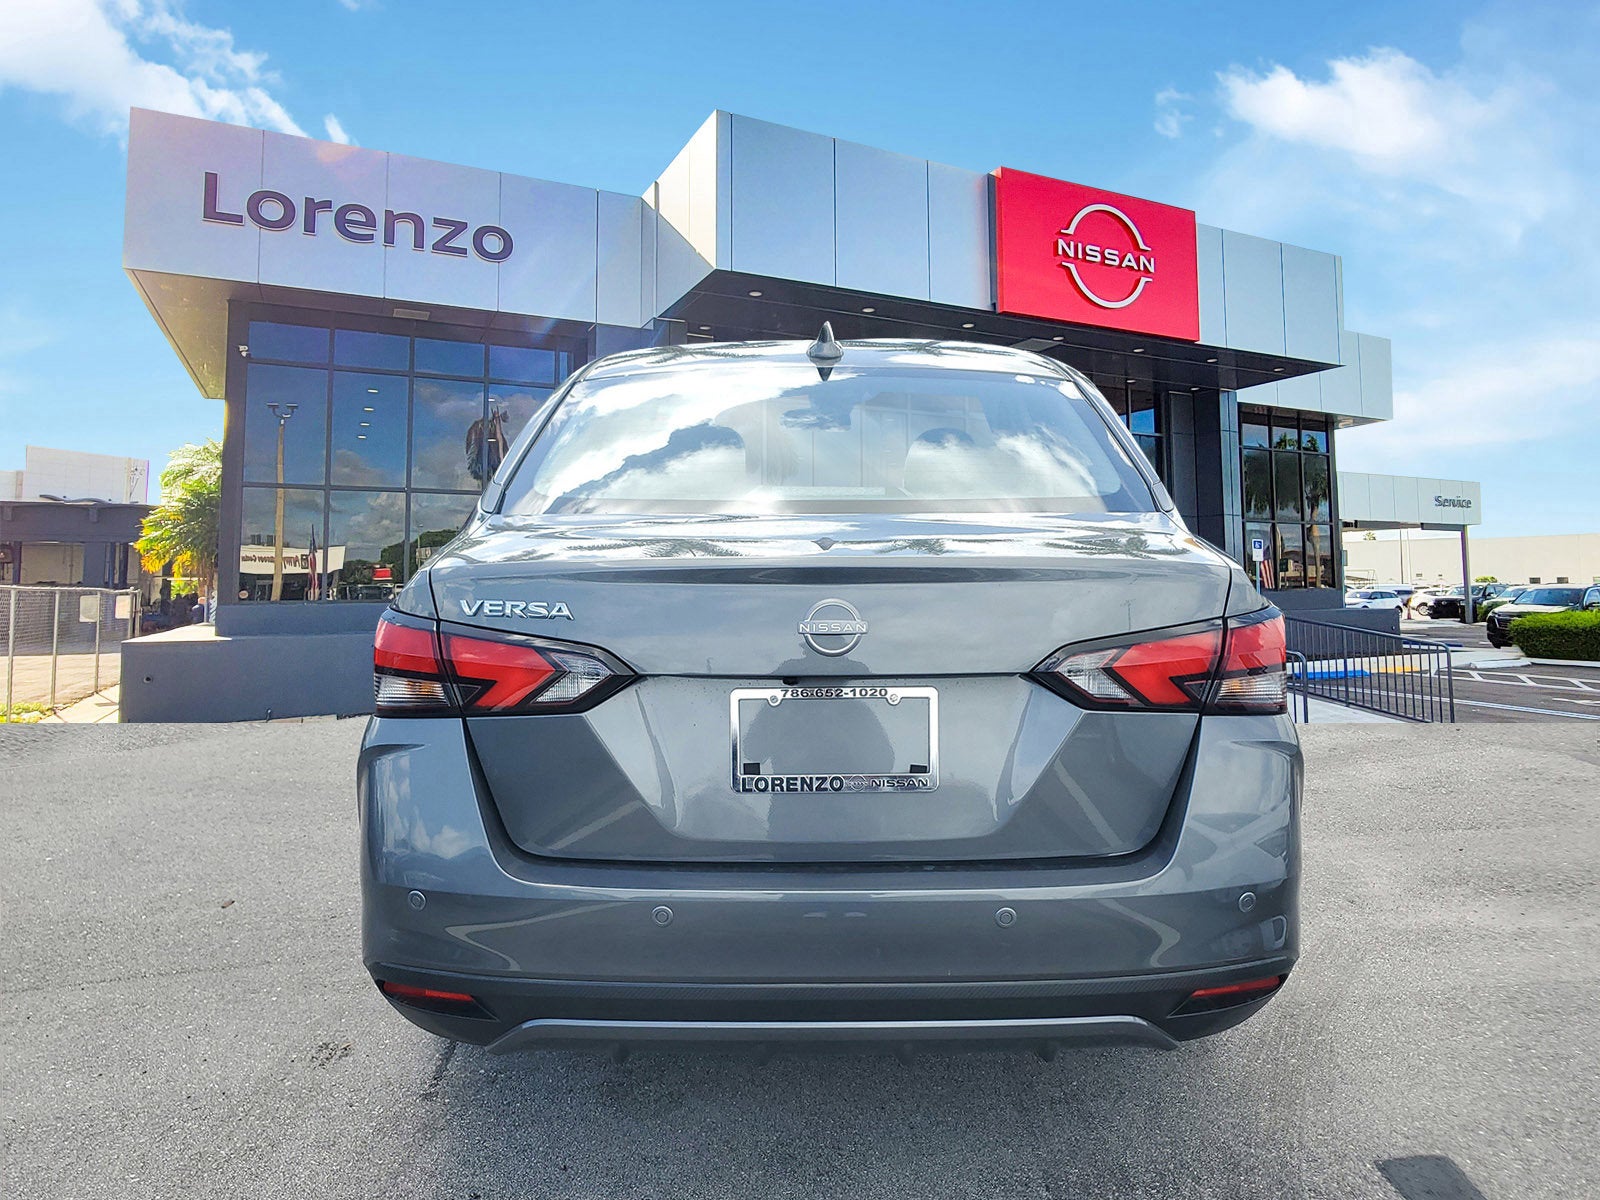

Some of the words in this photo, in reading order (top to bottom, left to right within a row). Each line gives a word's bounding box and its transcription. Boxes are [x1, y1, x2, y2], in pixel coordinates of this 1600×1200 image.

[202, 170, 515, 263] Lorenzo
[1057, 239, 1155, 273] NISSAN
[1434, 495, 1472, 508] Service
[459, 599, 575, 621] VERSA
[799, 623, 868, 633] NISSAN
[741, 776, 844, 792] LORENZO
[870, 779, 929, 788] NISSAN
